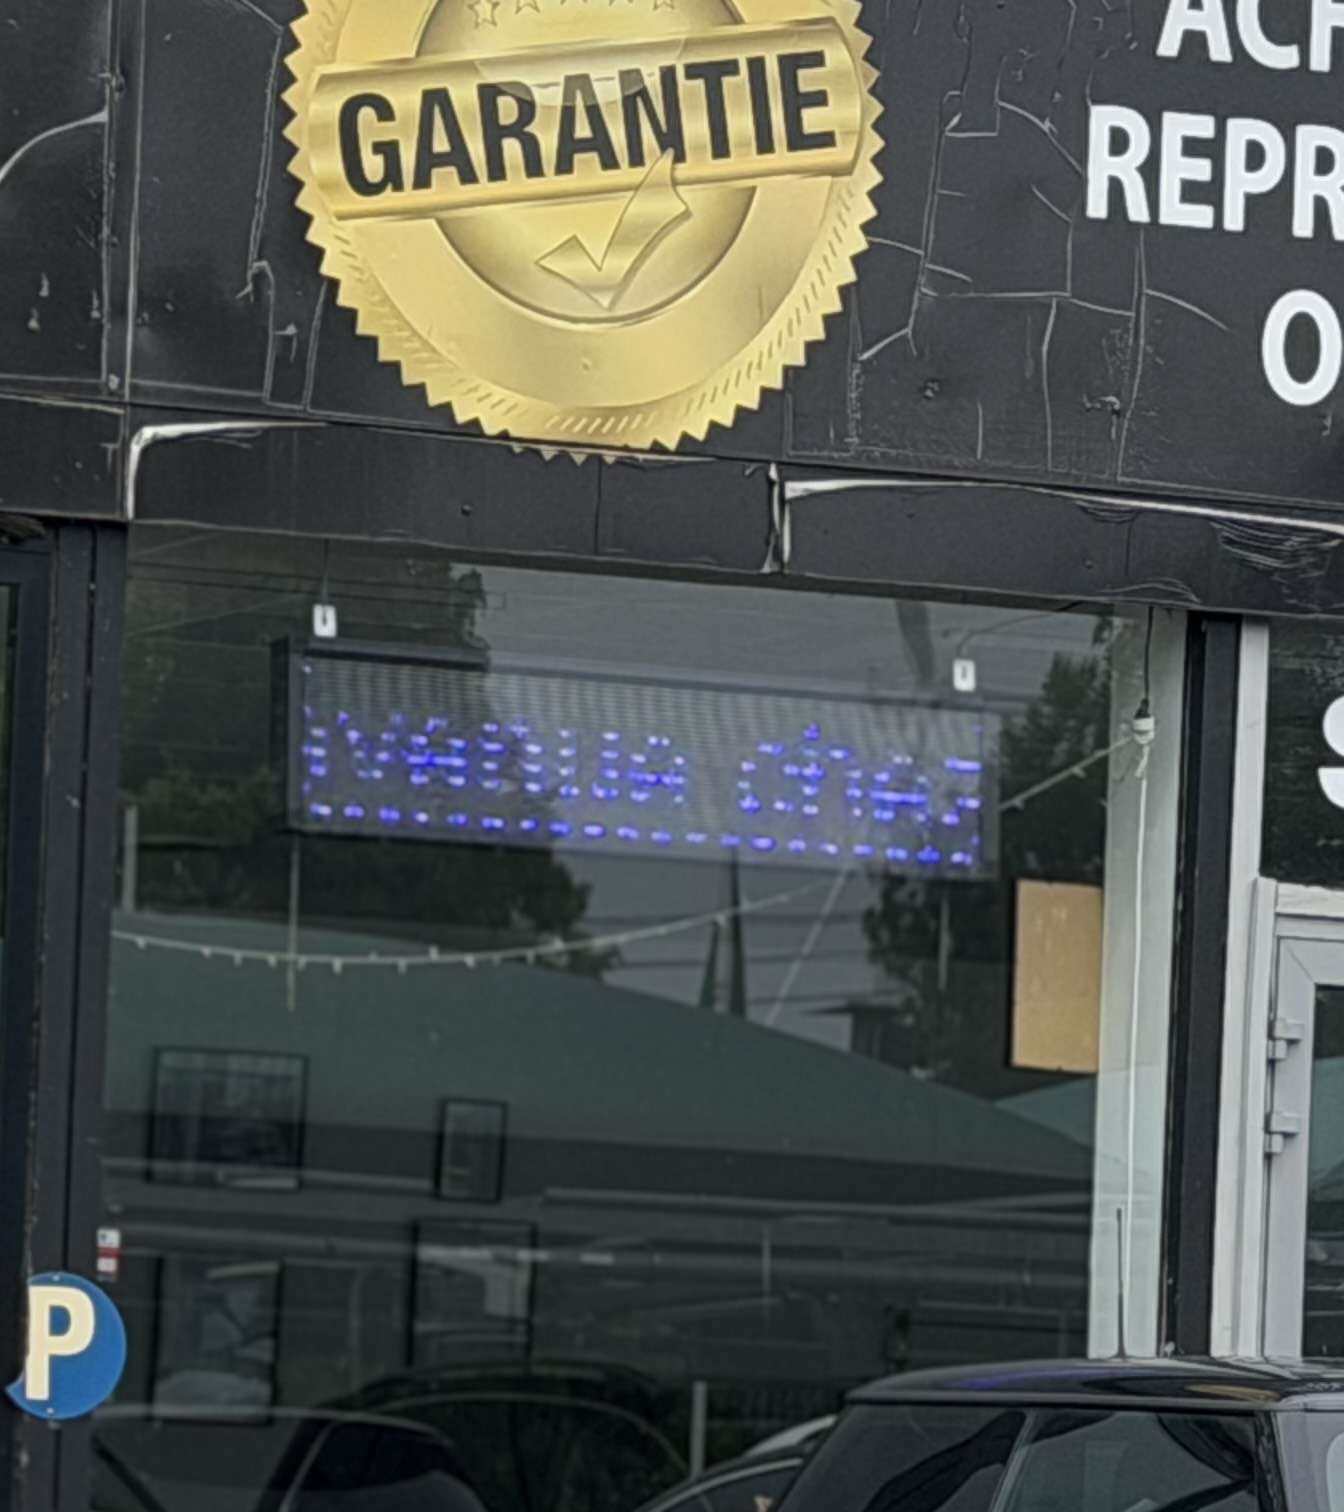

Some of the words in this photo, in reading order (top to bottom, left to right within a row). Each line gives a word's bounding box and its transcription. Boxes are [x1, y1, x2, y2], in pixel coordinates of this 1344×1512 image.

[338, 49, 836, 198] GARANTIE
[1086, 104, 1344, 241] REPR
[1262, 289, 1343, 406] O
[25, 1285, 96, 1401] P
